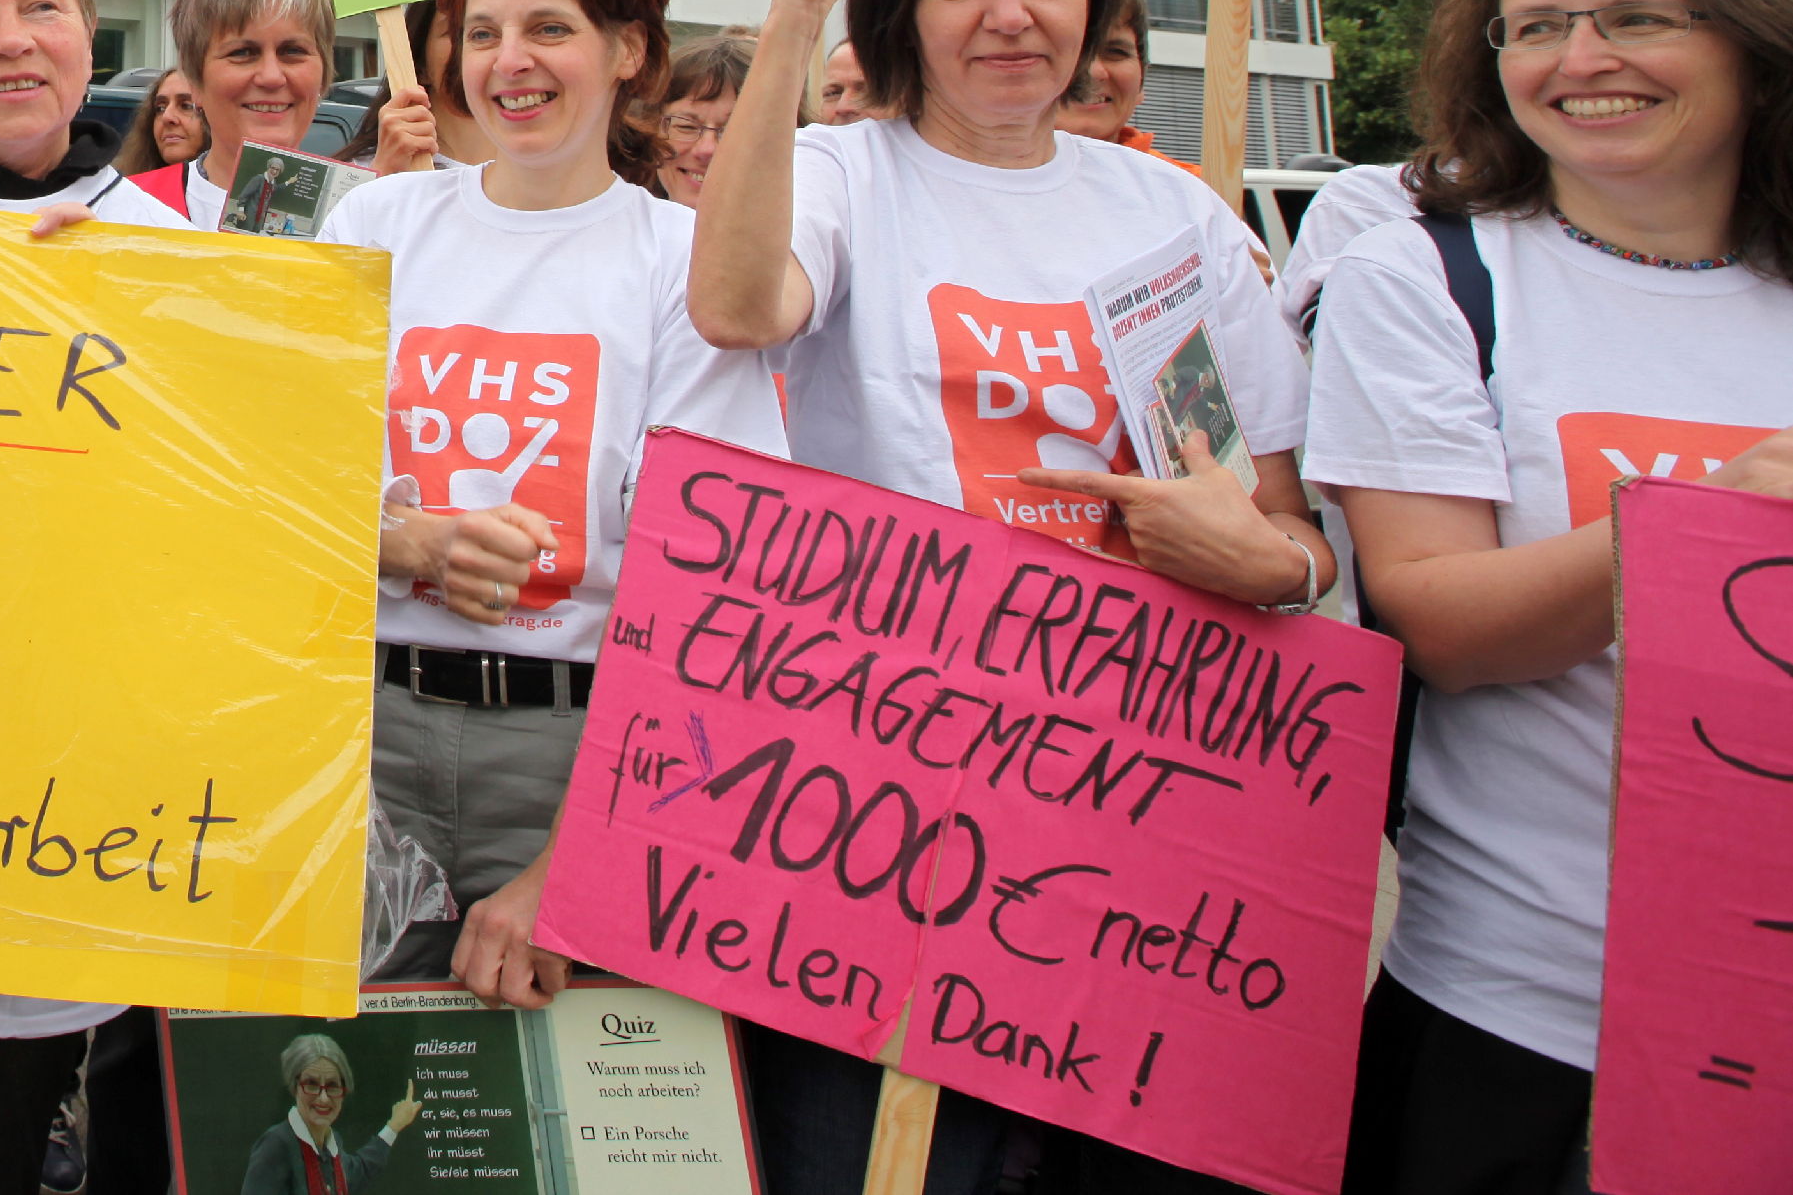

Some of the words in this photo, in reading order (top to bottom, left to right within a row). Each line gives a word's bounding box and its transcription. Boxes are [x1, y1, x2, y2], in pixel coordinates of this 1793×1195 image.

[1105, 291, 1135, 321] WARUM
[1131, 283, 1151, 305] WIR
[956, 312, 1106, 373] VH
[418, 352, 573, 406] VHS
[662, 471, 974, 673] STUDIUM,
[975, 562, 1368, 807] ERFAHRUNG,
[610, 613, 654, 657] und
[675, 590, 1245, 828] ENGAGEMENT
[606, 711, 686, 829] für
[1092, 891, 1288, 1012] netto
[643, 845, 883, 1023] Vielen
[929, 973, 1098, 1095] Dank
[390, 995, 480, 1009] Berlin-Brandenburg,
[601, 1013, 657, 1040] Quiz
[414, 1039, 477, 1055] müssen
[416, 1066, 434, 1079] ich
[438, 1069, 469, 1079] muss
[586, 1061, 640, 1075] Warum
[644, 1064, 681, 1075] muss
[683, 1061, 706, 1075] ich
[423, 1088, 438, 1099] du
[441, 1087, 480, 1099] musst
[599, 1083, 633, 1098] noch
[637, 1082, 701, 1098] arbeiten?
[421, 1109, 437, 1121] er,
[439, 1107, 460, 1121] sie,
[462, 1109, 477, 1118] es
[480, 1107, 512, 1117] muss
[424, 1127, 441, 1139] wir
[445, 1126, 490, 1139] müssen
[603, 1126, 630, 1141] Ein
[633, 1125, 690, 1141] Porsche
[427, 1146, 443, 1158] ihr
[447, 1146, 486, 1158] müsst
[607, 1148, 648, 1163] reicht
[651, 1149, 682, 1163] mir
[681, 1148, 723, 1163] nicht.
[429, 1165, 470, 1178] Sie/sie
[473, 1165, 519, 1177] müssen
